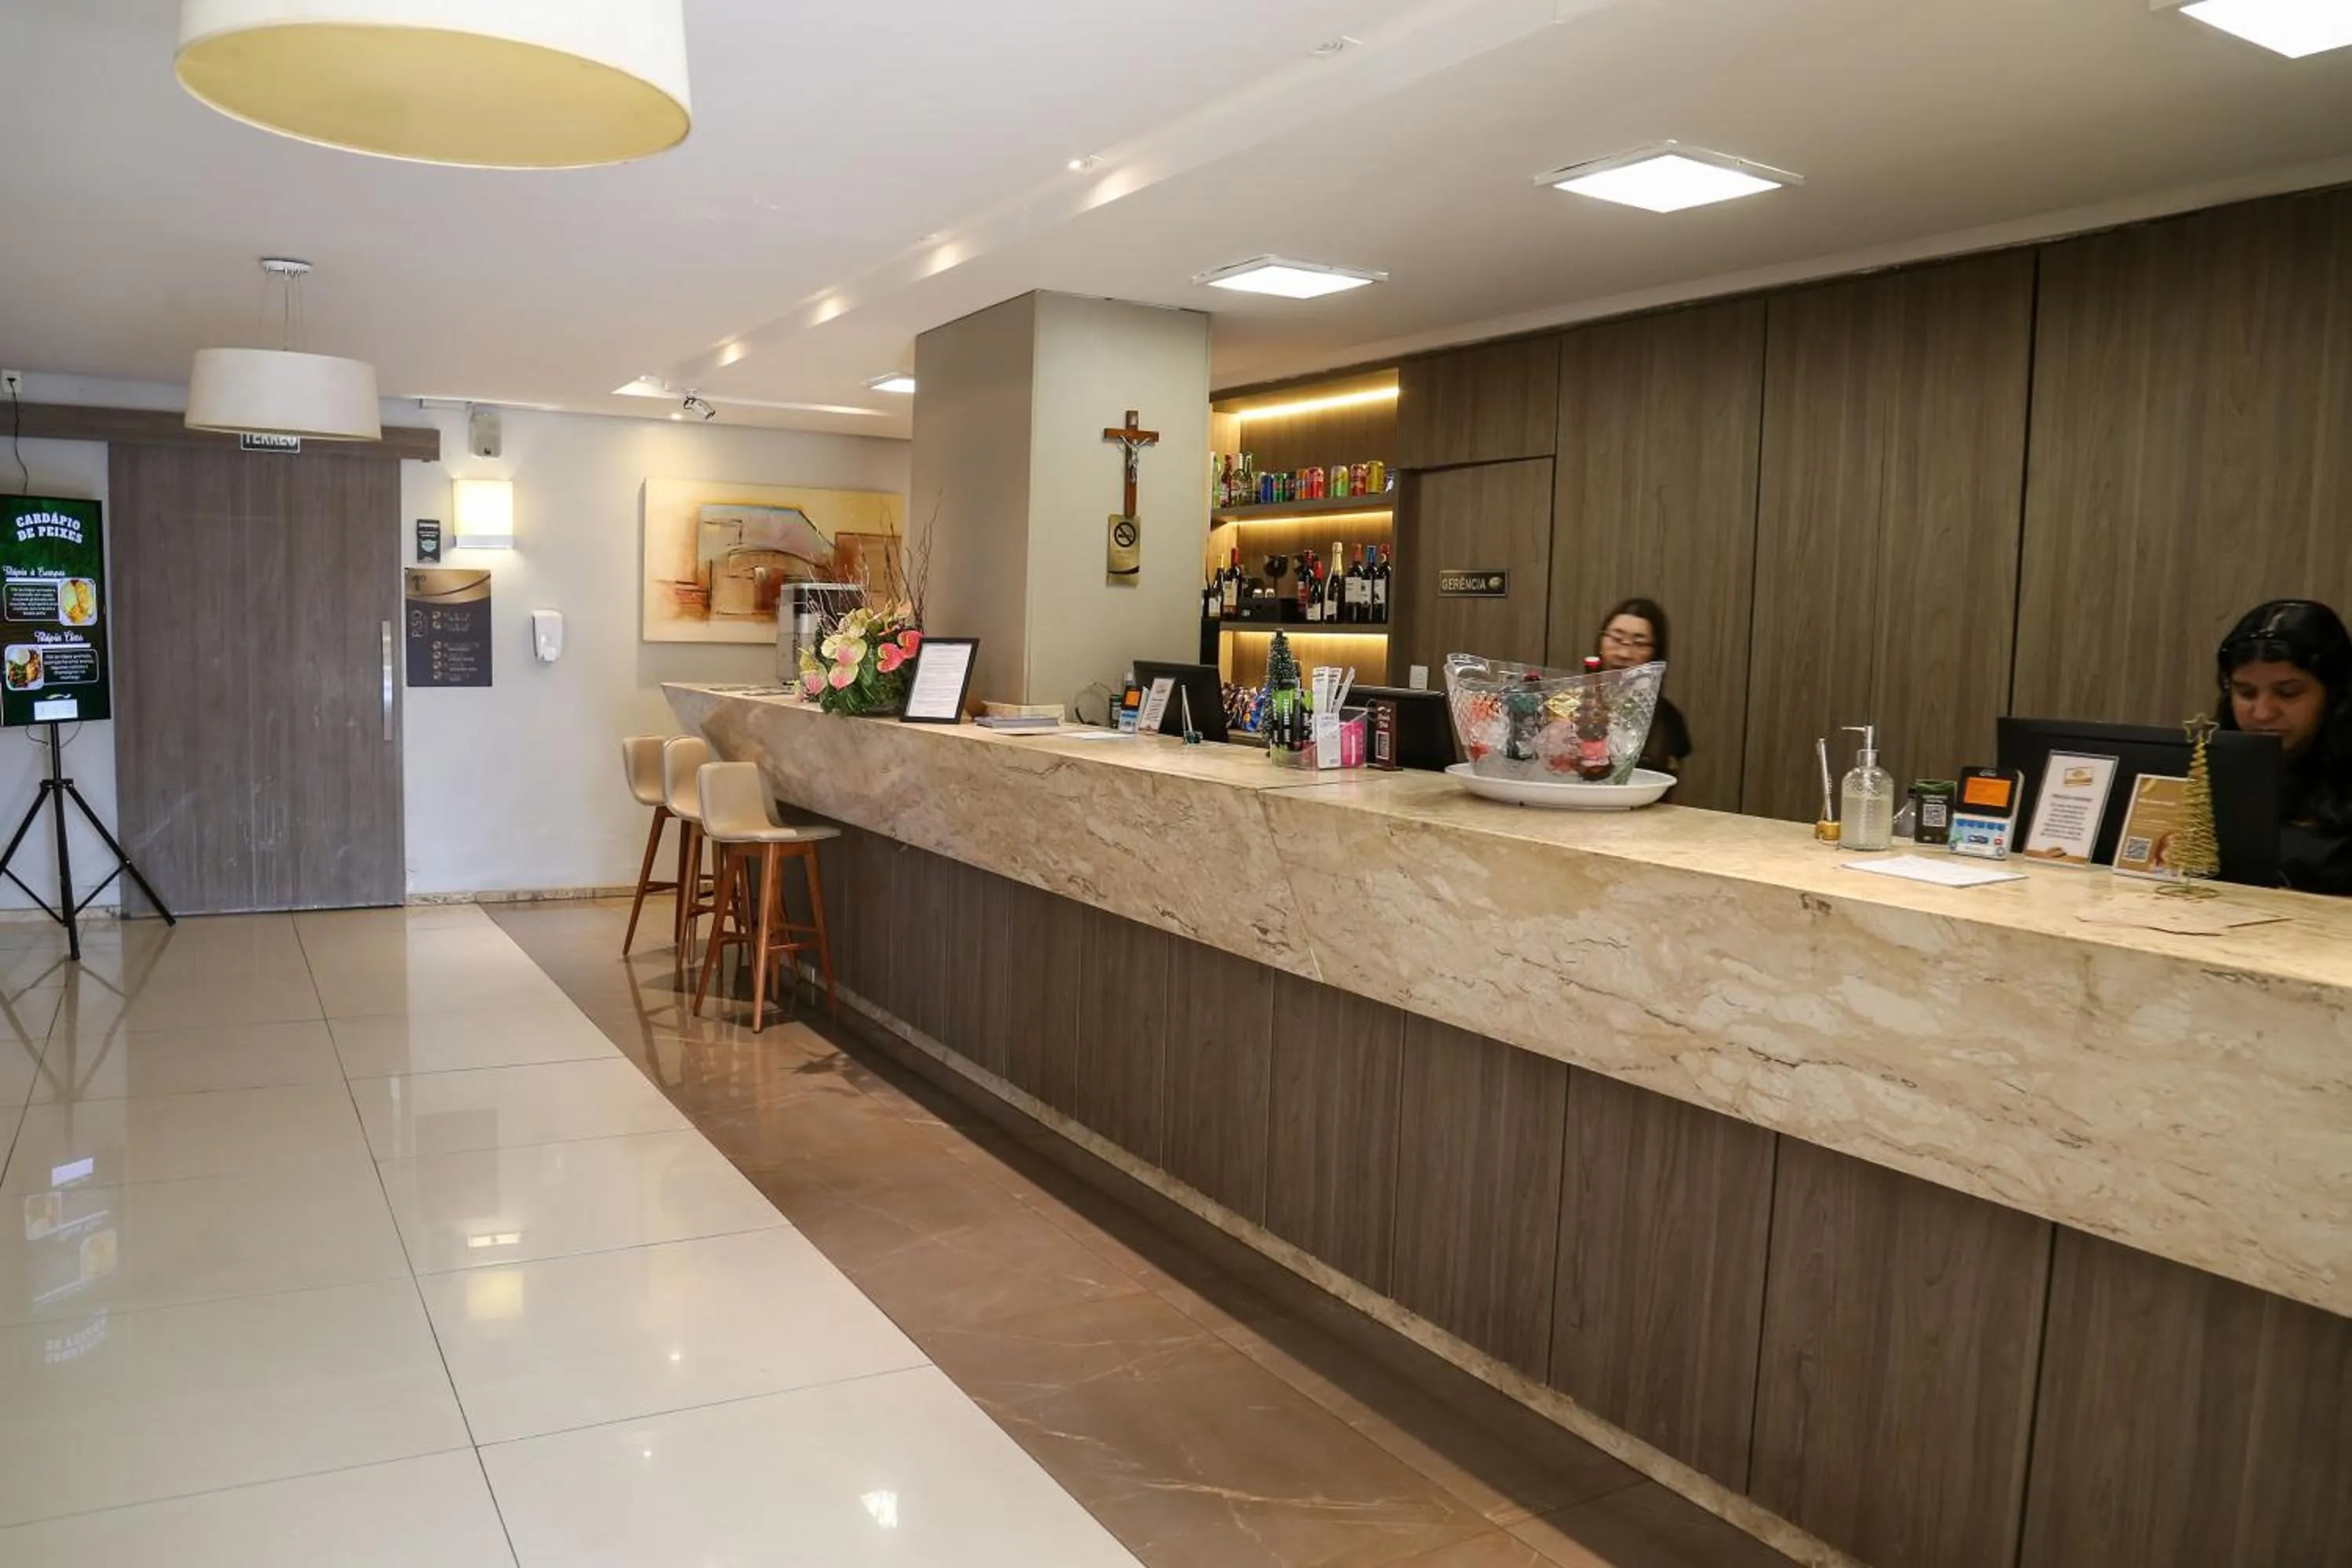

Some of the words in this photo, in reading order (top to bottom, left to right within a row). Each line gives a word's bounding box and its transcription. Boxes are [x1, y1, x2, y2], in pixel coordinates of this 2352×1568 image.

[16, 511, 81, 531] CARDÁPIO
[16, 528, 35, 542] DE
[38, 526, 83, 544] PEIXES
[1442, 575, 1486, 590] GERÊNCIA
